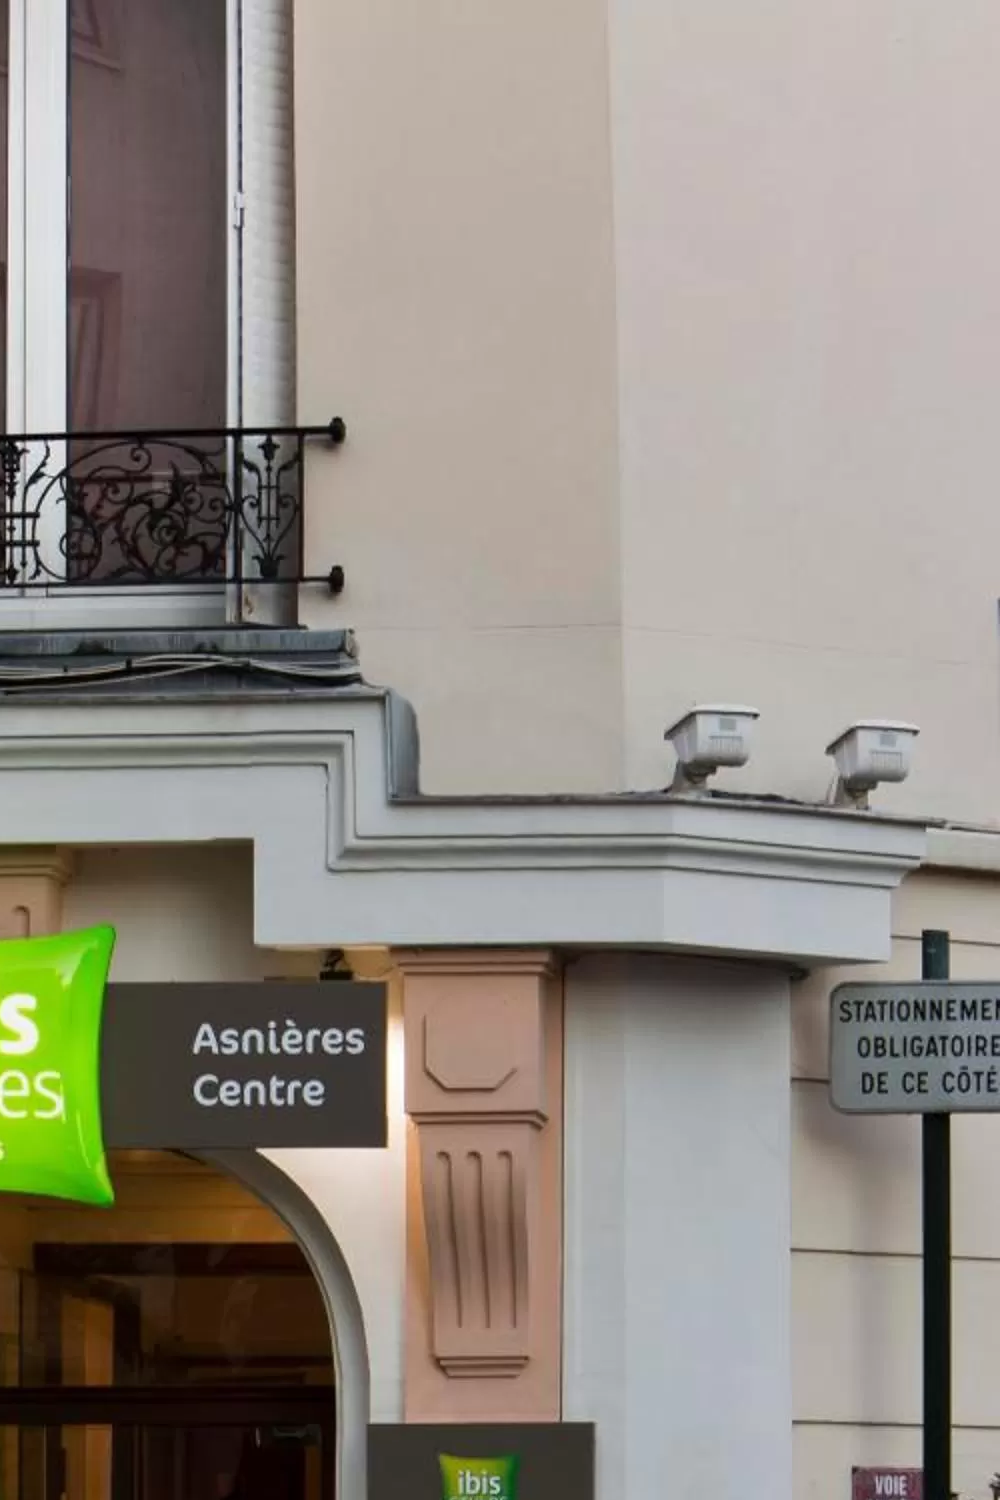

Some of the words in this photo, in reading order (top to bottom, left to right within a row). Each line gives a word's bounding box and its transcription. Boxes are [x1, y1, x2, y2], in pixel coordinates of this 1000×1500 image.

[192, 1019, 365, 1055] Asnières
[857, 1035, 1000, 1058] OBLIGATOIRE
[192, 1073, 326, 1106] Centre
[861, 1071, 889, 1094] DE
[901, 1071, 929, 1094] CE
[942, 1065, 999, 1094] CÔTÉ
[458, 1469, 501, 1495] ibis
[875, 1475, 907, 1496] VOIE
